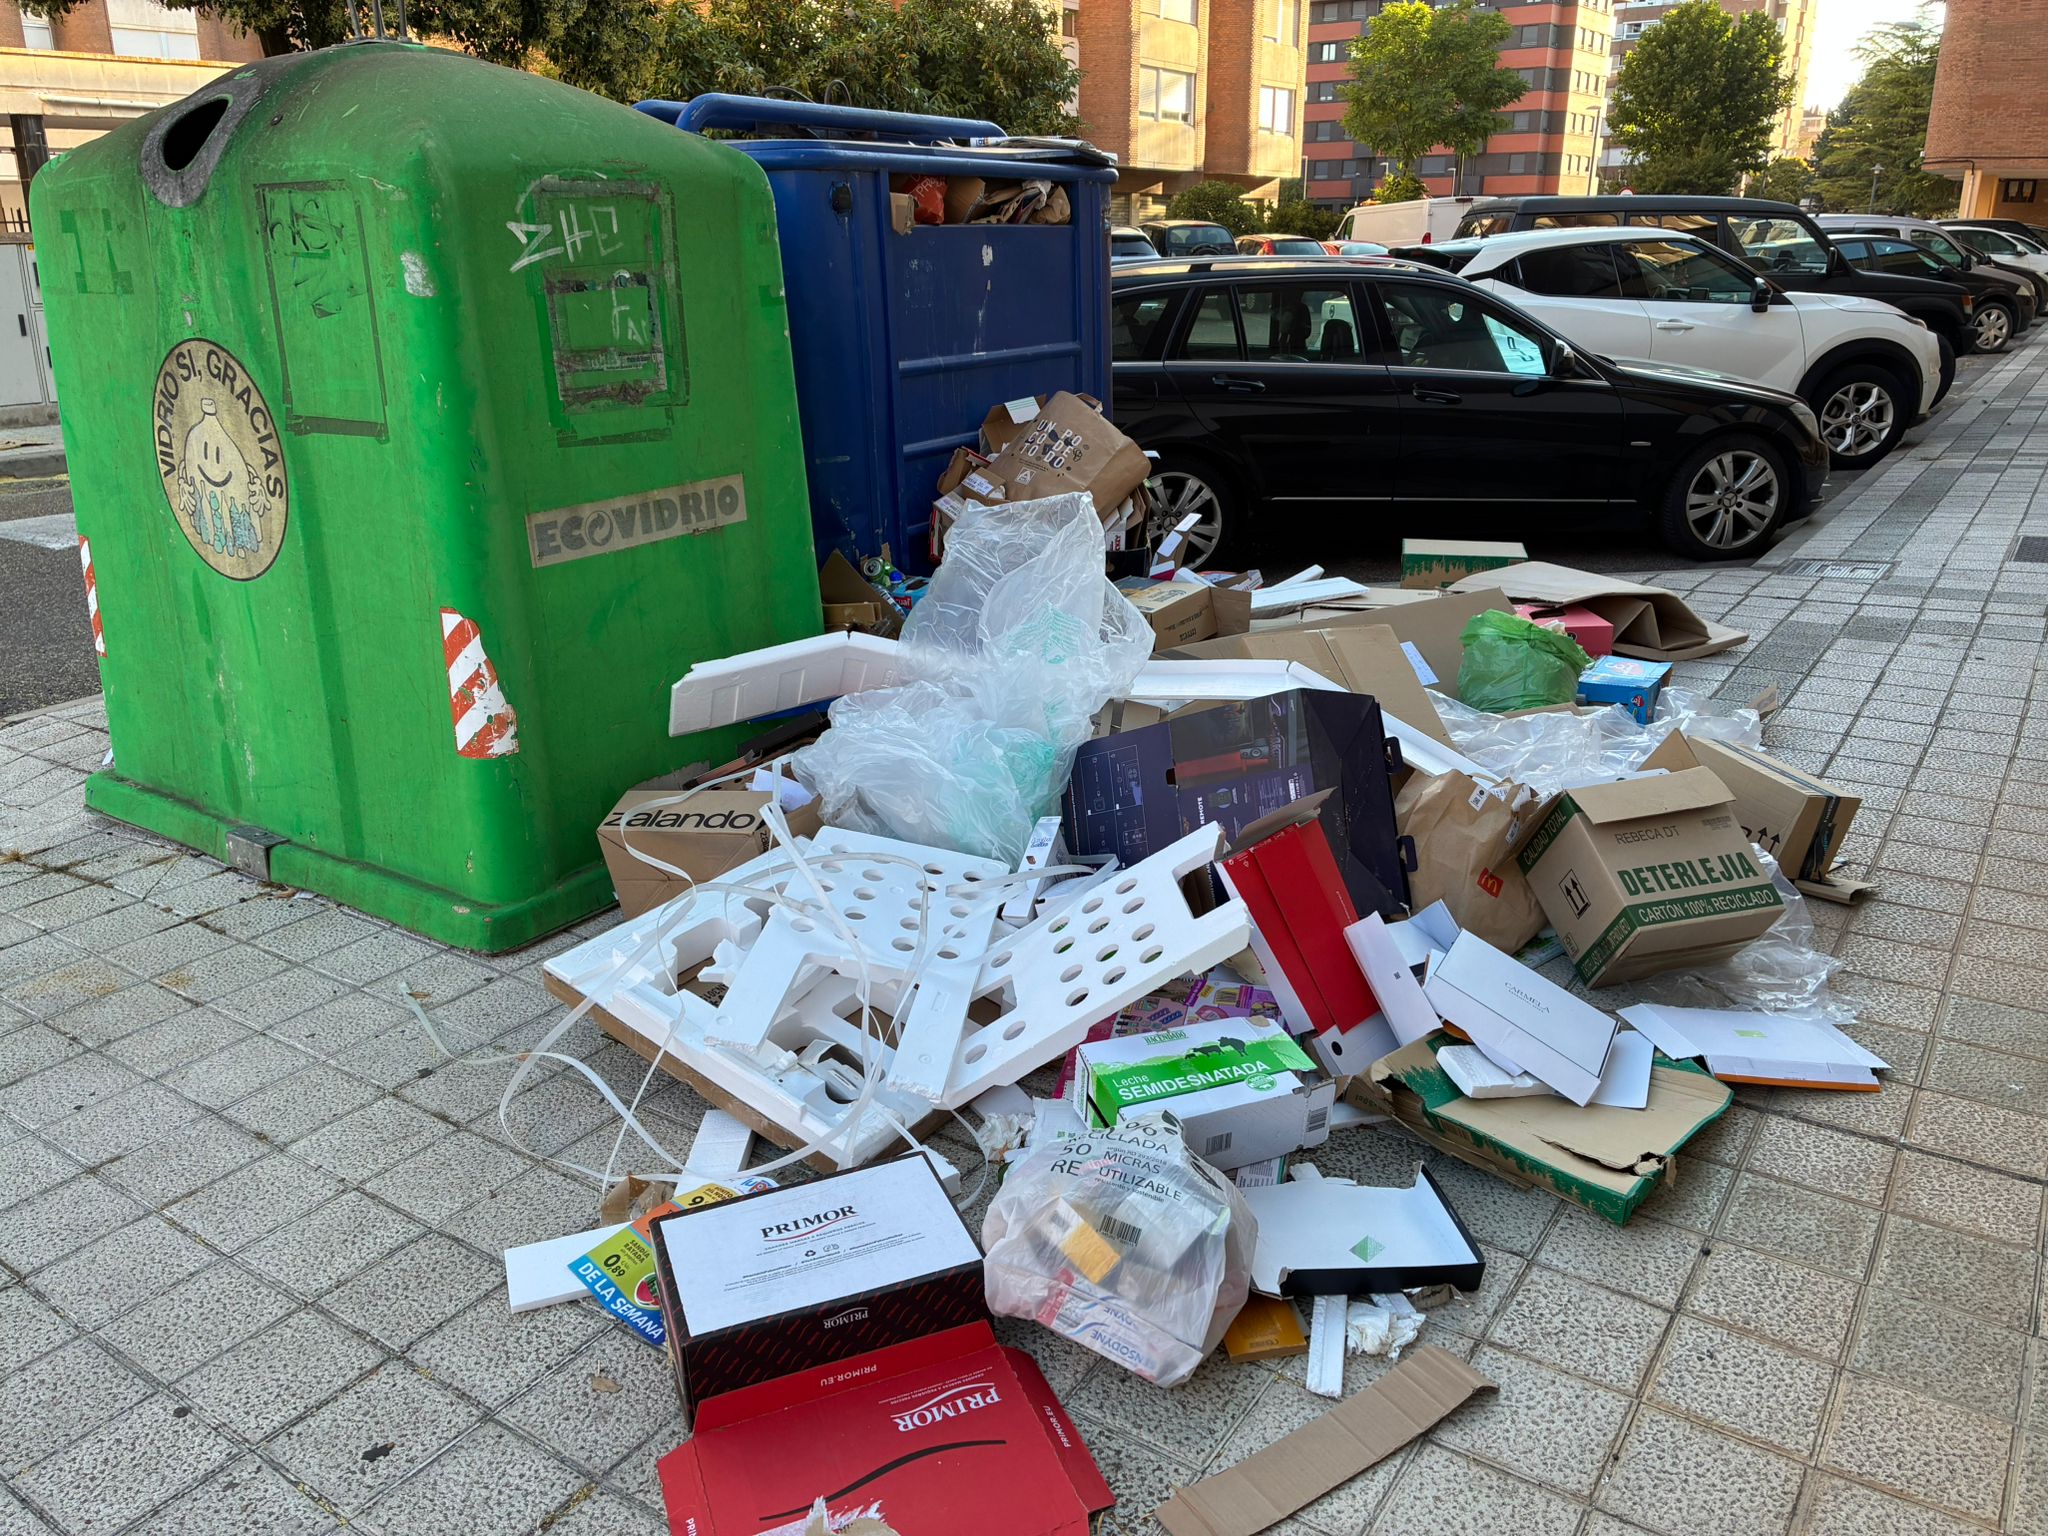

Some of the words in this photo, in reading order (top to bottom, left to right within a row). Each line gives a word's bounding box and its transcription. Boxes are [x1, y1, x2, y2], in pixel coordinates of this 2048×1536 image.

[156, 371, 179, 478] VIDRIO
[206, 349, 284, 499] GRACIAS
[603, 809, 756, 829] zalando
[1615, 828, 1664, 845] REBECA
[1663, 826, 1680, 838] DT
[1523, 828, 1548, 865] CALIDAD
[1544, 811, 1568, 839] TOTAL
[1617, 852, 1759, 897] DETERLEJIA
[1638, 901, 1684, 922] CARTÓN
[1684, 895, 1713, 917] 100%
[1711, 889, 1774, 911] RECICLADO
[1112, 1073, 1149, 1088] Leche
[1119, 1060, 1271, 1101] SEMIDESNATADA
[1103, 1151, 1161, 1175] MICRAS
[1098, 1167, 1183, 1202] UTILIZABLE
[760, 1204, 857, 1239] PRIMOR
[578, 1262, 596, 1283] DE
[595, 1278, 612, 1301] LA
[611, 1299, 664, 1339] SEMANA
[822, 1307, 869, 1329] PRIMOR
[820, 1363, 877, 1387] PRIMOR.EU
[896, 1387, 1002, 1432] PRIMOR
[1042, 1404, 1072, 1448] PRIMOR.EU
